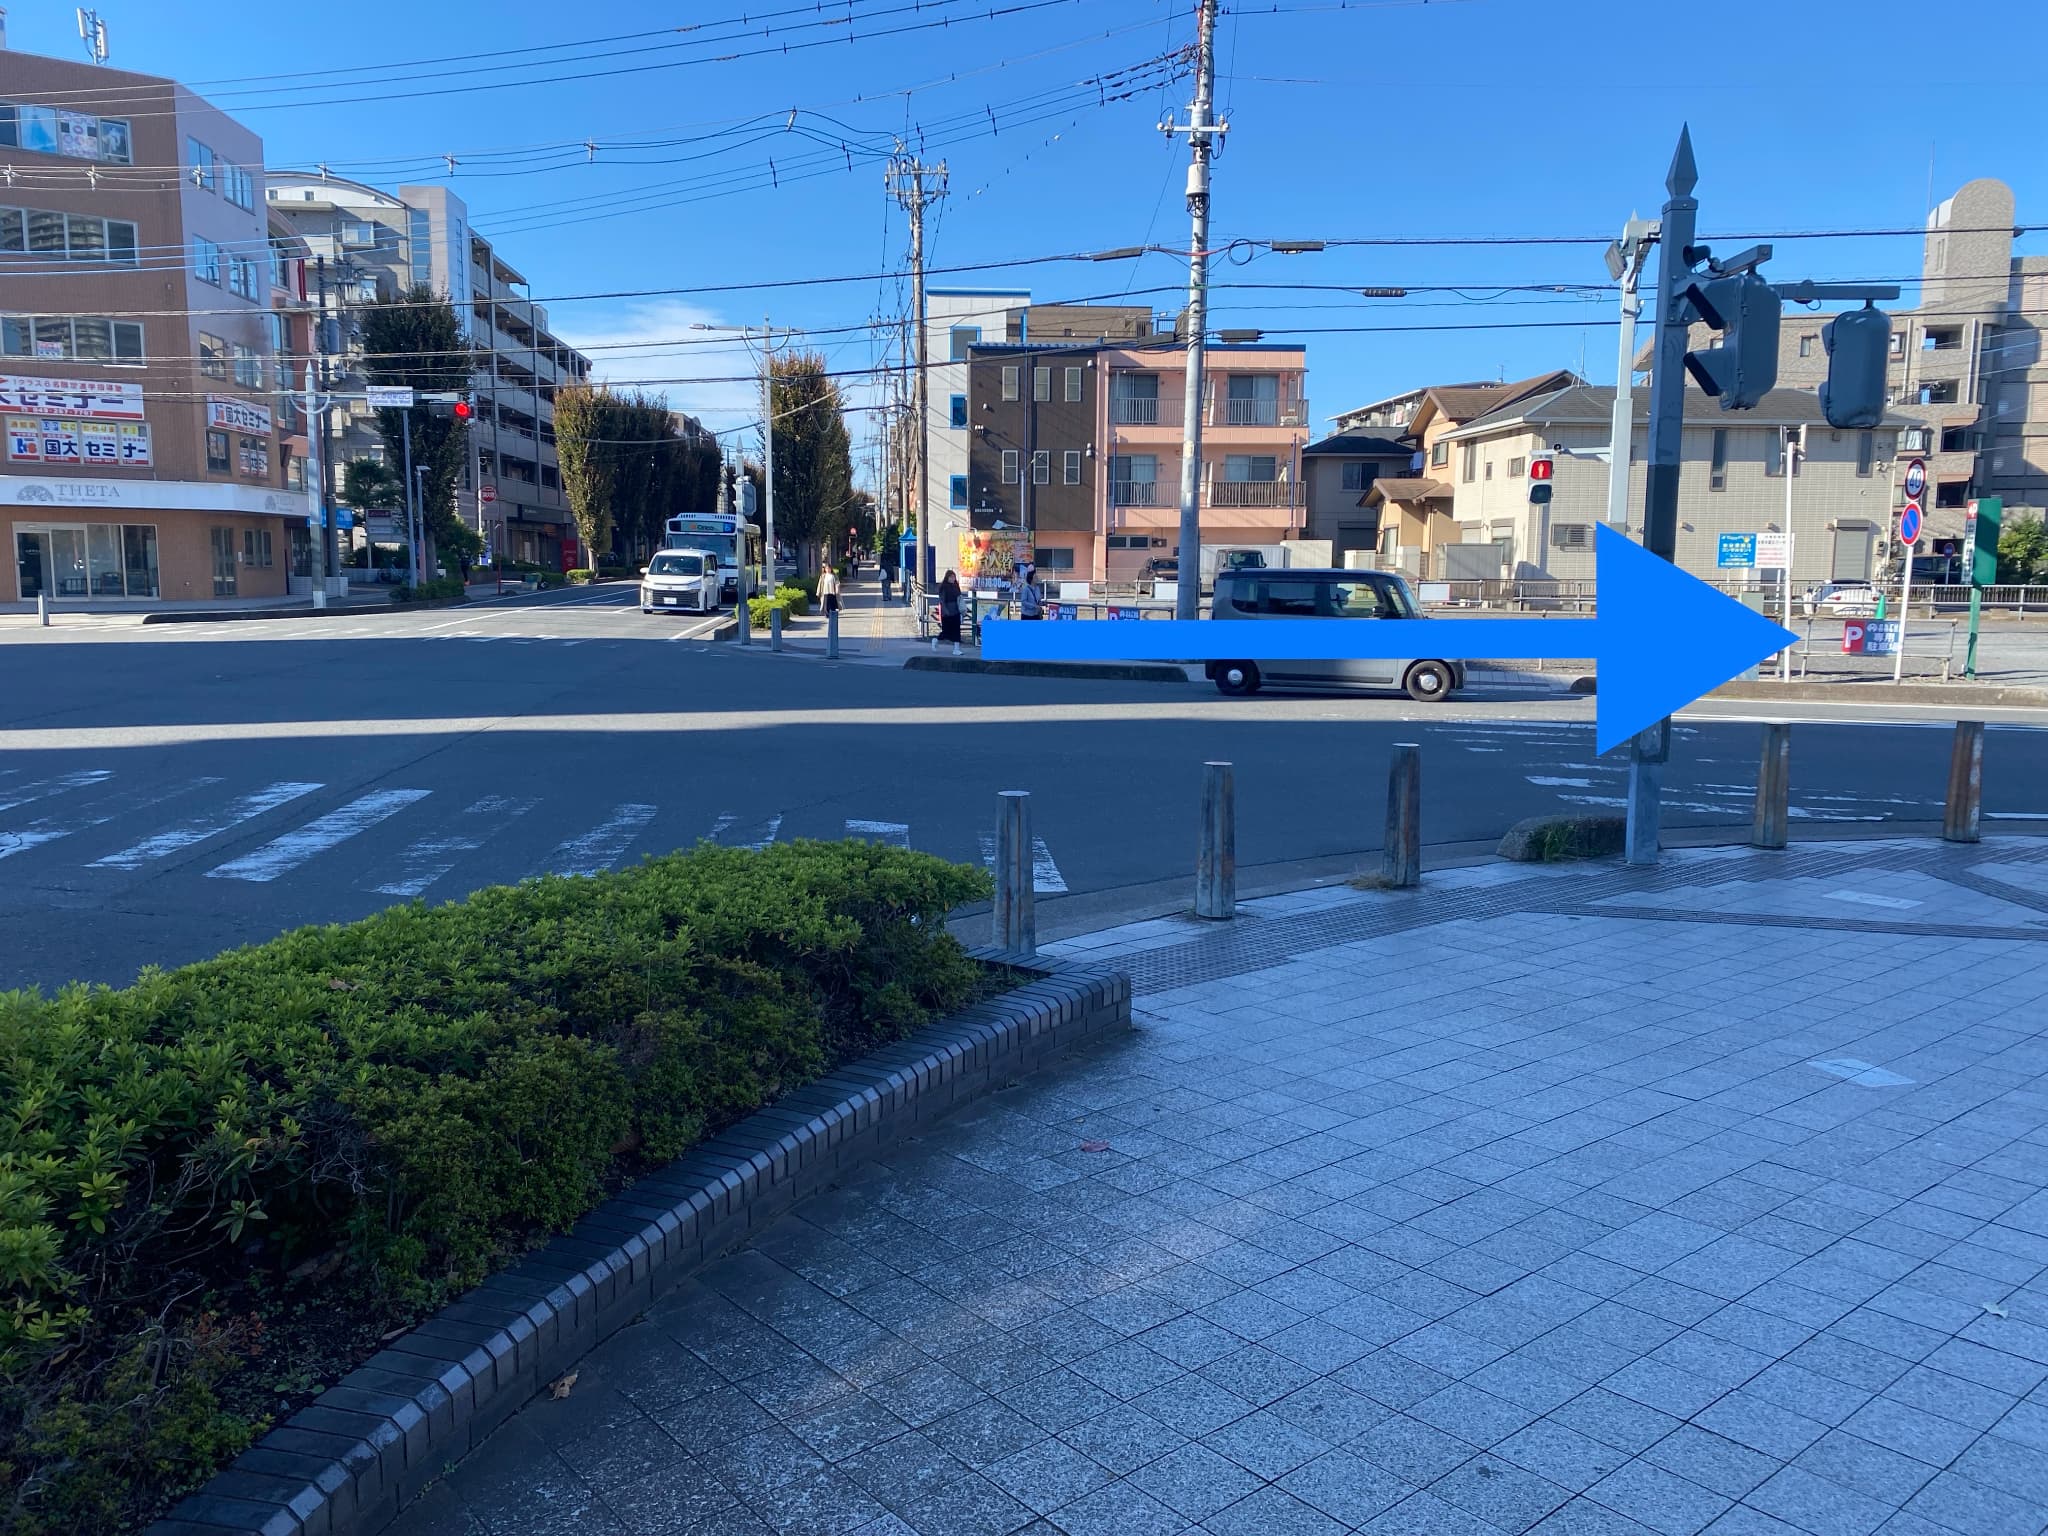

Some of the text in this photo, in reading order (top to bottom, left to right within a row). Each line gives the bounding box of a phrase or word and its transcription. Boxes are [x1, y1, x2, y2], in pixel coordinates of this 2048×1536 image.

[1909, 471, 1922, 489] 40
[55, 484, 120, 497] THETA
[1844, 626, 1863, 648] P
